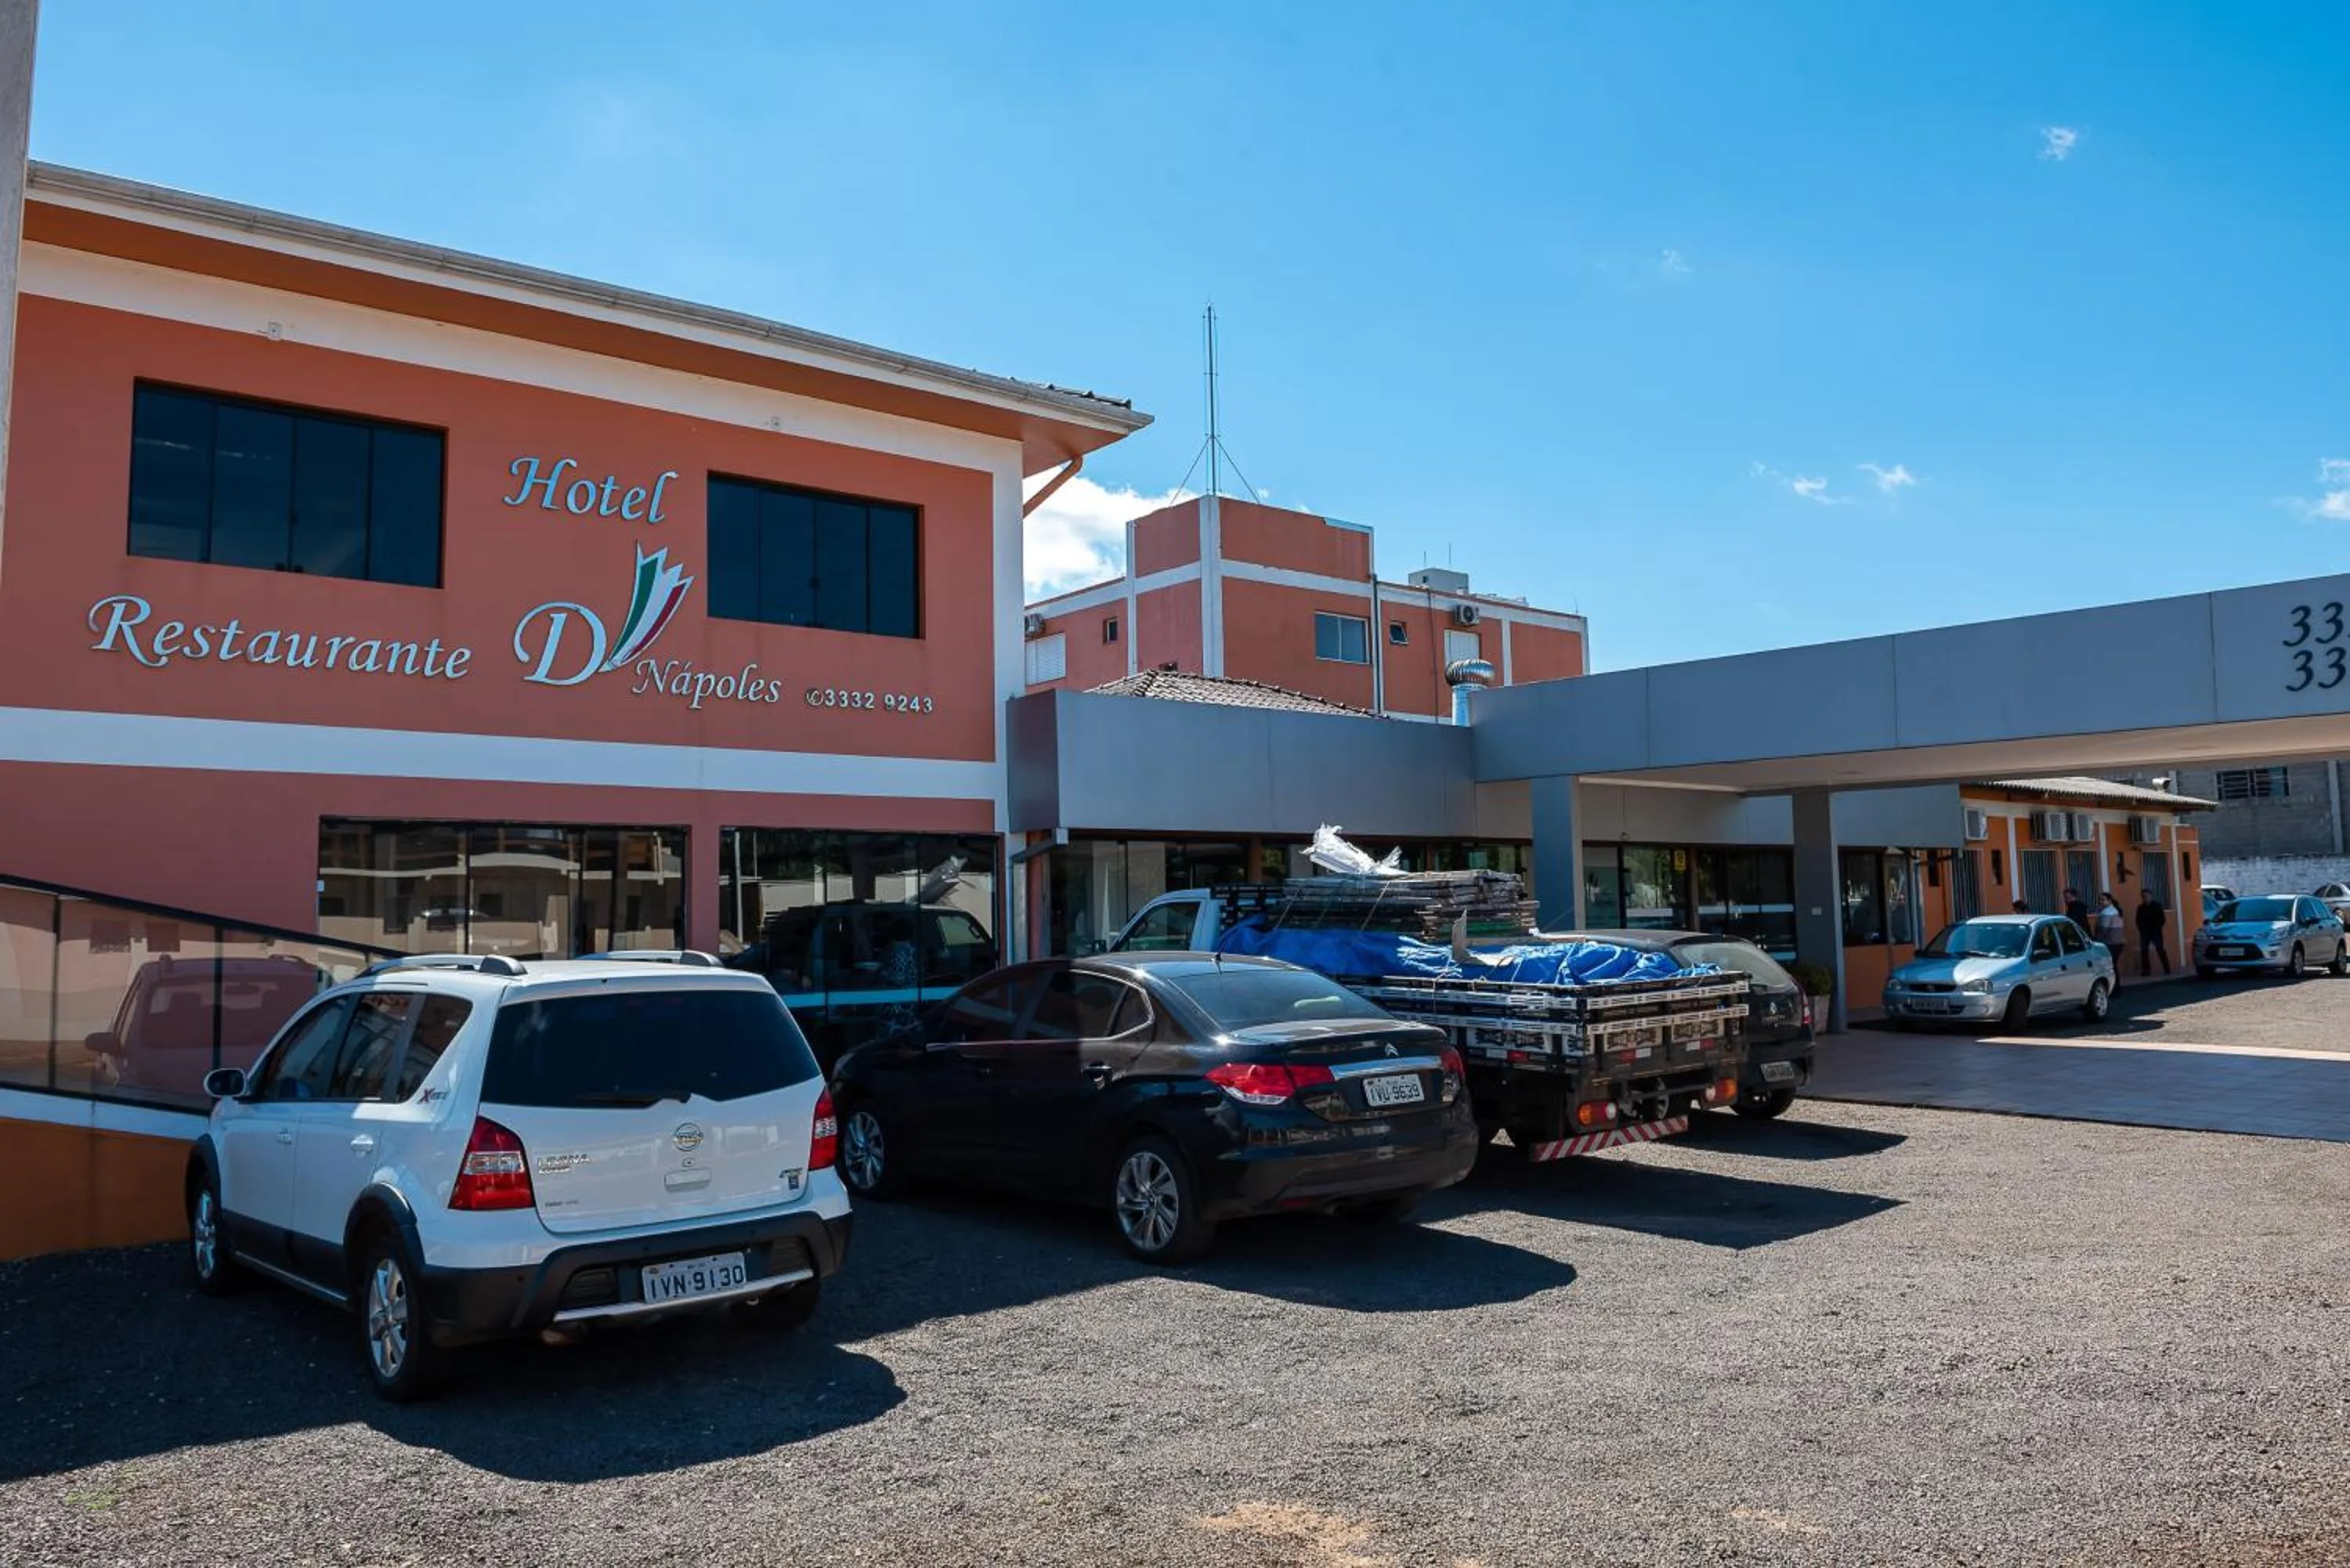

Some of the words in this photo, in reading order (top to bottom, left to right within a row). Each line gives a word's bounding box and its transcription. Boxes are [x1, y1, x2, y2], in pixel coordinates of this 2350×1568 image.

[503, 457, 680, 525] Hotel
[88, 594, 473, 680] Restaurante
[2282, 601, 2350, 648] 33
[631, 659, 783, 710] Nápoles
[824, 688, 876, 710] 3332
[884, 694, 933, 714] 9243
